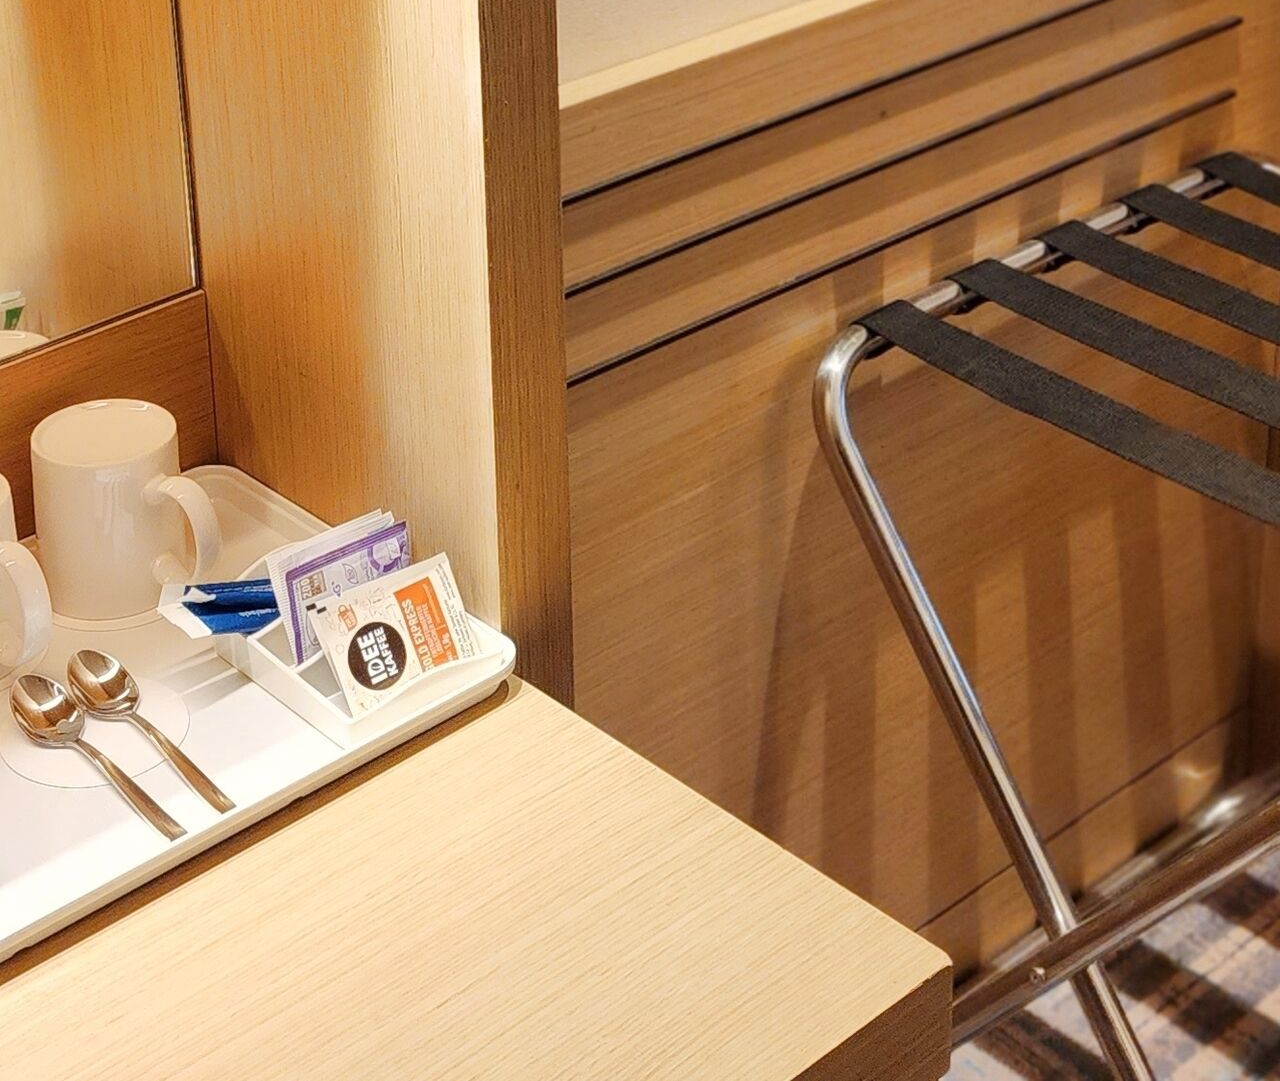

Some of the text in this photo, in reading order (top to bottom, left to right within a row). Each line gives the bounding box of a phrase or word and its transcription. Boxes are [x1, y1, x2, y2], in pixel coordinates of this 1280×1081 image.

[300, 577, 313, 598] 200
[401, 598, 425, 644] EXPRESS
[356, 632, 389, 686] IDEE
[373, 626, 399, 678] KAFFEE
